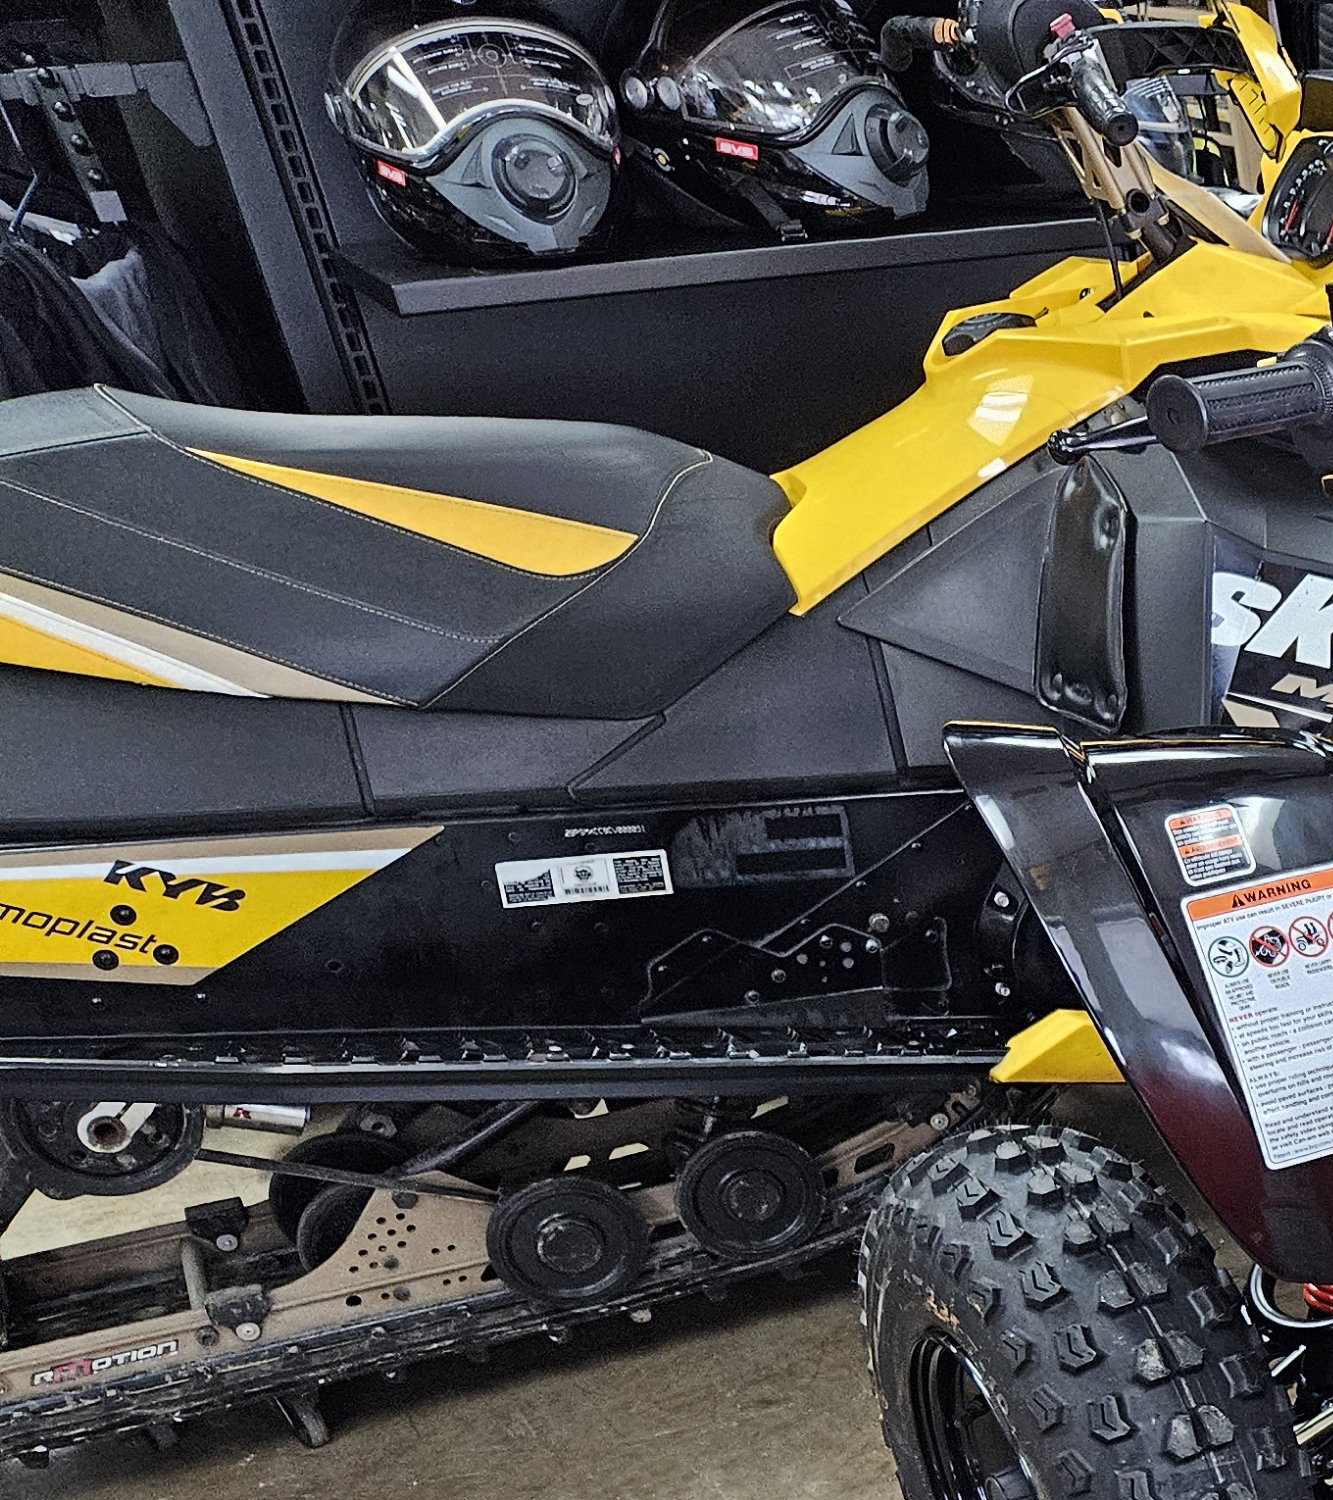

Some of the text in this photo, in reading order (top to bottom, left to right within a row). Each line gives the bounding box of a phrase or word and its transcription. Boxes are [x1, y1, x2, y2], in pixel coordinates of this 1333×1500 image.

[103, 859, 247, 912] KYB
[1243, 879, 1312, 903] WARNING
[1196, 920, 1221, 931] Improper
[1258, 907, 1274, 915] result
[1281, 900, 1303, 909] SEVERE
[1305, 895, 1324, 903] INJURY
[1228, 1013, 1253, 1022] NEVER
[1236, 1020, 1258, 1029] without
[1260, 1016, 1280, 1024] proper
[1280, 1009, 1304, 1019] training
[1246, 1027, 1268, 1037] speeds
[1250, 1035, 1269, 1044] public
[1297, 1021, 1323, 1031] collision
[1244, 1044, 1267, 1054] another
[1266, 1046, 1297, 1058] passenger
[1249, 1060, 1274, 1071] steering
[1287, 1050, 1313, 1060] increase
[1267, 1077, 1287, 1086] proper
[1288, 1072, 1306, 1081] riding
[1257, 1086, 1286, 1097] overturns
[1260, 1098, 1277, 1106] avoid
[1277, 1093, 1296, 1102] paved
[1297, 1085, 1323, 1096] surfaces
[1281, 1099, 1307, 1110] handling
[1264, 1120, 1281, 1128] Read
[1294, 1107, 1328, 1120] understand
[1267, 1127, 1285, 1135] locate
[1280, 1131, 1298, 1140] safety
[1300, 1126, 1316, 1134] video
[1317, 1121, 1333, 1129] using
[1293, 1134, 1317, 1144] Can-am
